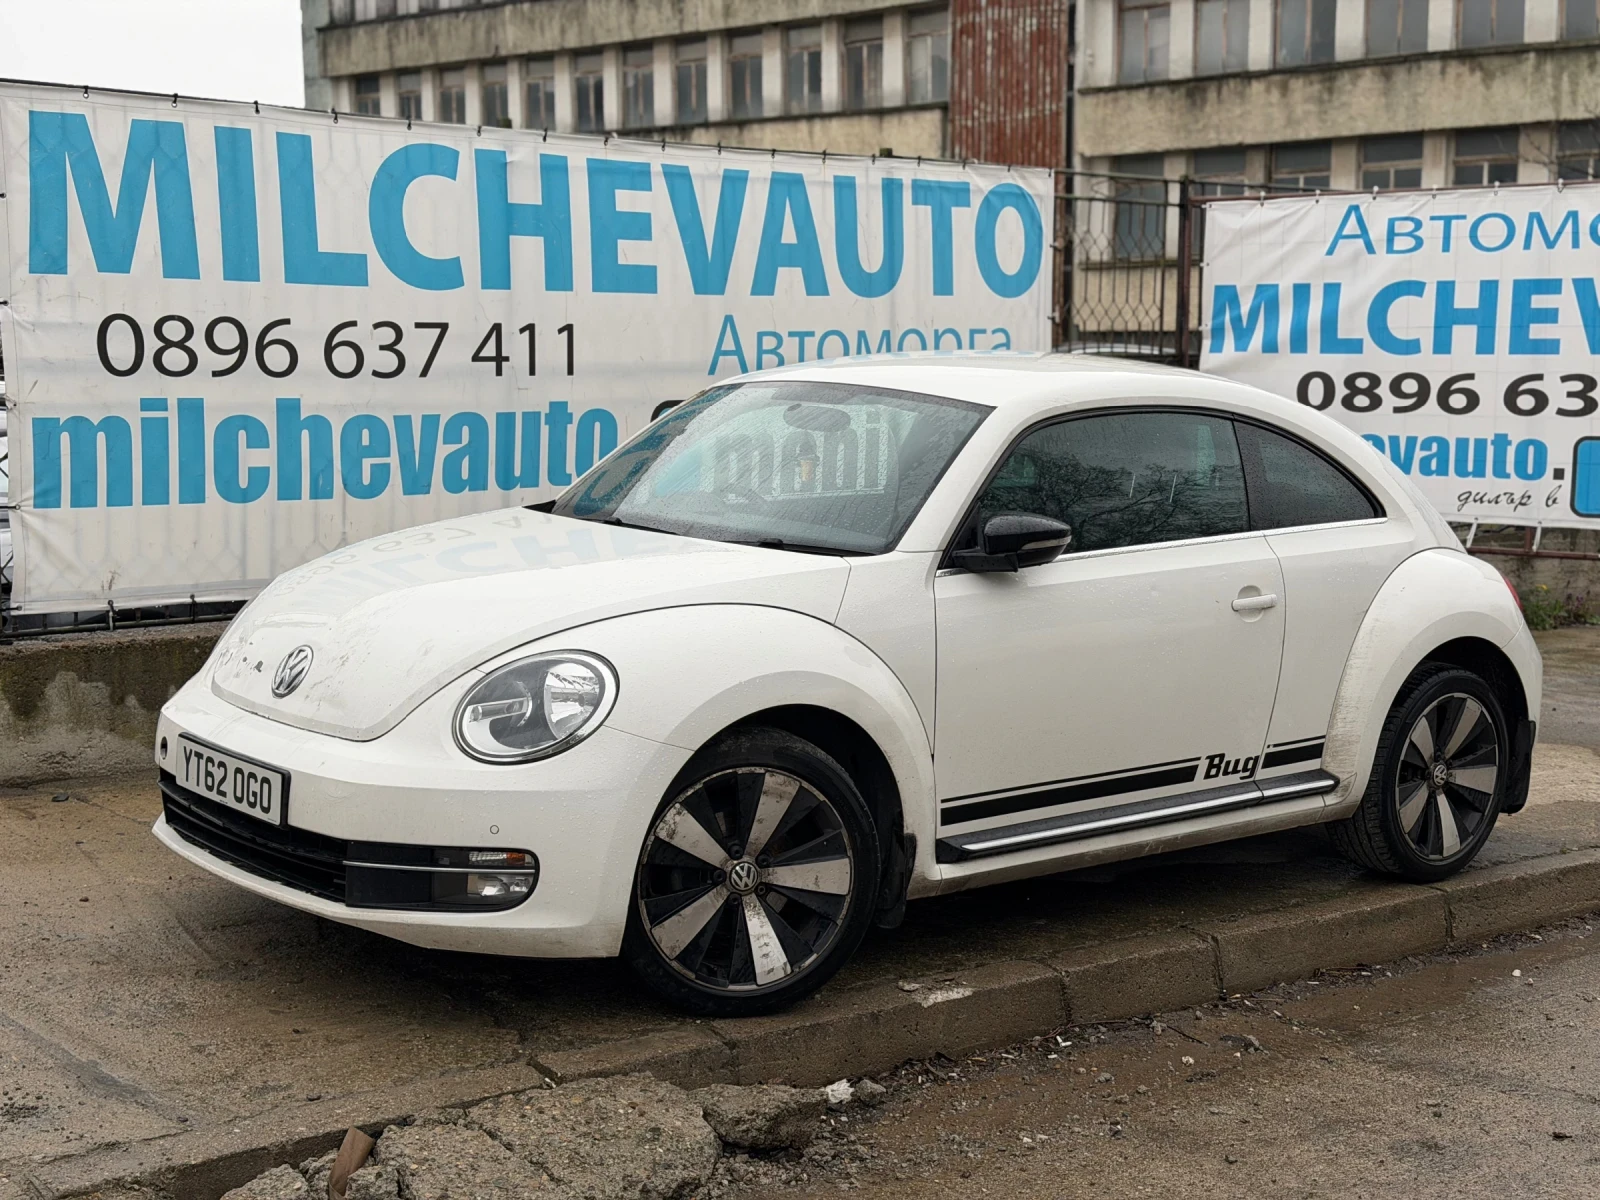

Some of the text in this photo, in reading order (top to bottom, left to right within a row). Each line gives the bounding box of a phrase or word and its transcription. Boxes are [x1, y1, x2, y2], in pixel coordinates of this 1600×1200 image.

[29, 110, 1043, 299] MILCHEVAUTO
[1325, 204, 1600, 256] Автом
[97, 313, 575, 379] 0896 637 411
[1296, 371, 1480, 415] 0896
[31, 397, 618, 509] milchevauto
[1457, 489, 1532, 512] дилър
[183, 745, 272, 814] YT62 OGO
[1203, 752, 1260, 780] Bug
